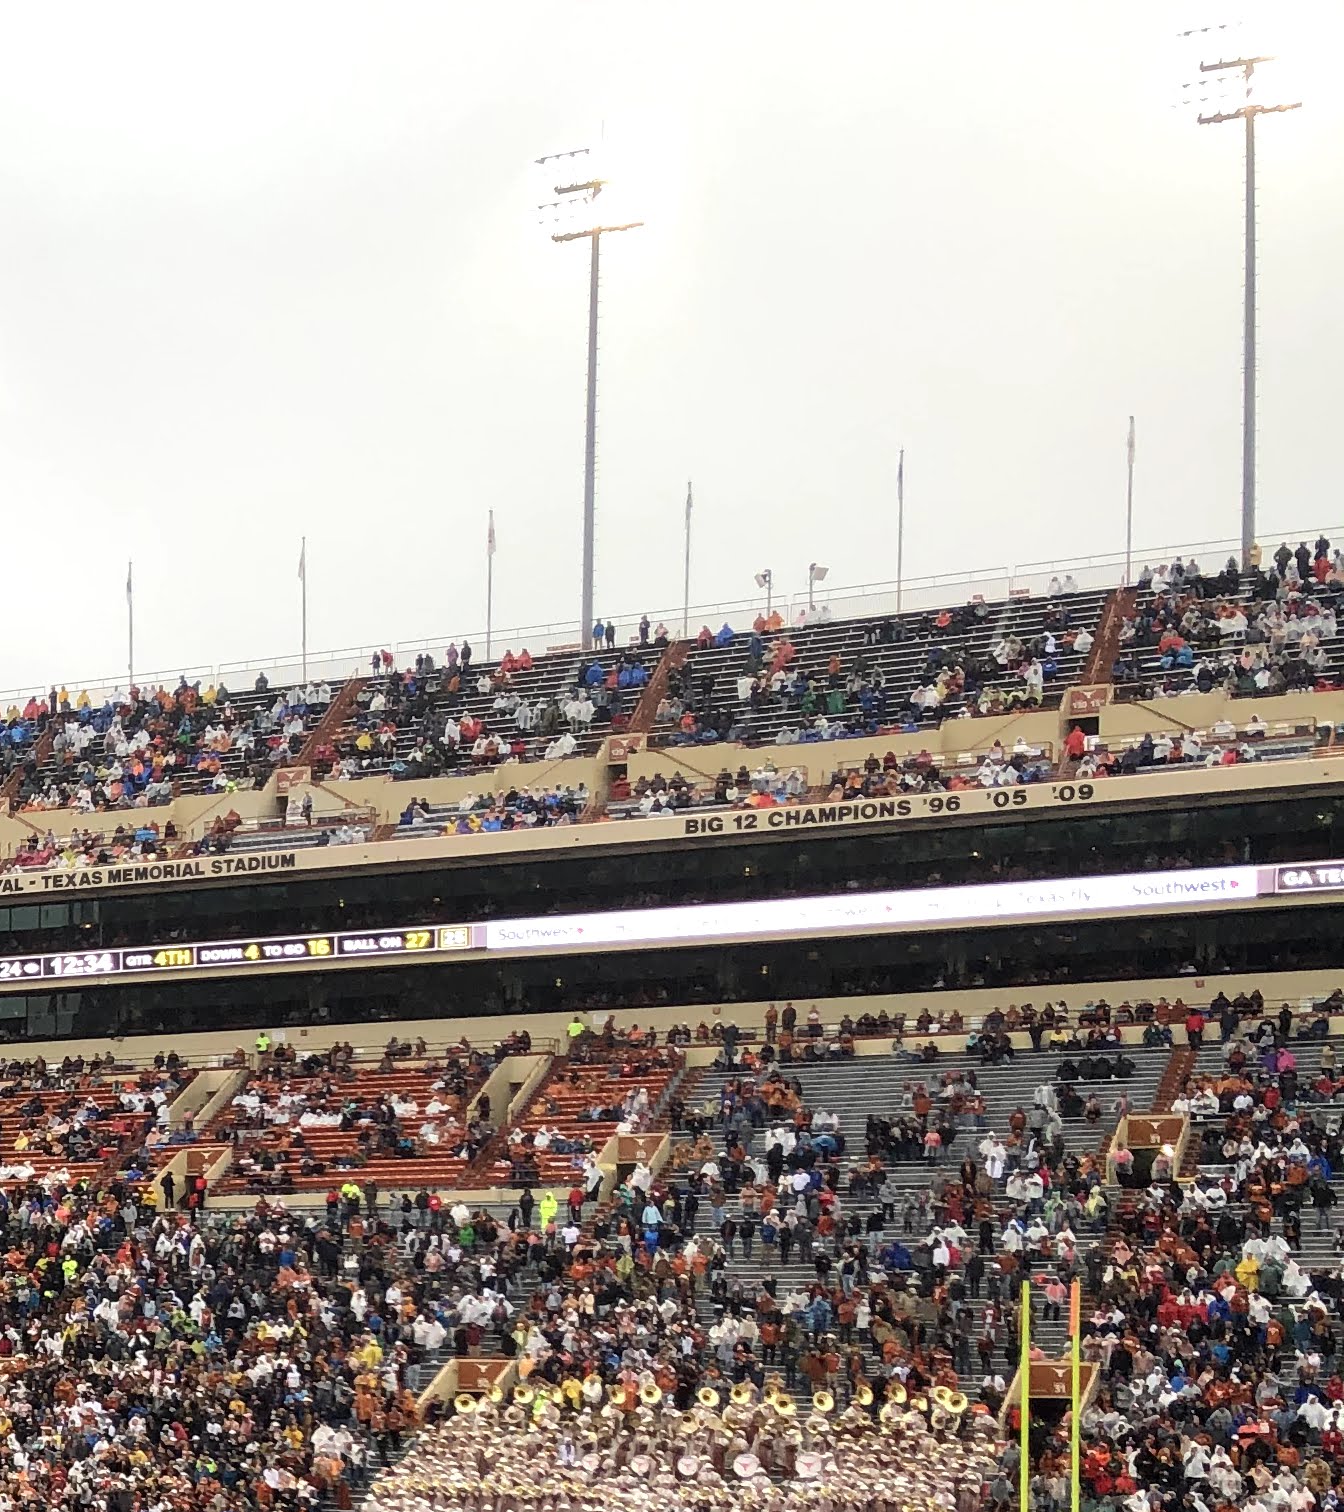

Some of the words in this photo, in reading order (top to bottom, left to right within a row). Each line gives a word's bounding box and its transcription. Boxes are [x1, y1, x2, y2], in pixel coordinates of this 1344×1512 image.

[685, 817, 723, 834] BIG
[733, 814, 757, 830] 12
[768, 800, 912, 827] CHAMPIONS
[922, 795, 961, 813] '96
[986, 789, 1027, 808] '05
[1052, 783, 1094, 802] '09
[41, 871, 102, 890] TEXAS
[108, 863, 205, 883] MEMORIAL
[211, 854, 295, 874] STADIUM
[1283, 871, 1313, 886] GA
[200, 947, 242, 962] DOWN
[244, 944, 259, 961] 4
[263, 945, 281, 958] TO
[307, 938, 330, 955] 16
[343, 938, 378, 951] BALL
[380, 937, 402, 949] ON
[404, 932, 431, 948] 27
[49, 953, 114, 977] 12:34
[154, 949, 191, 967] 4TH
